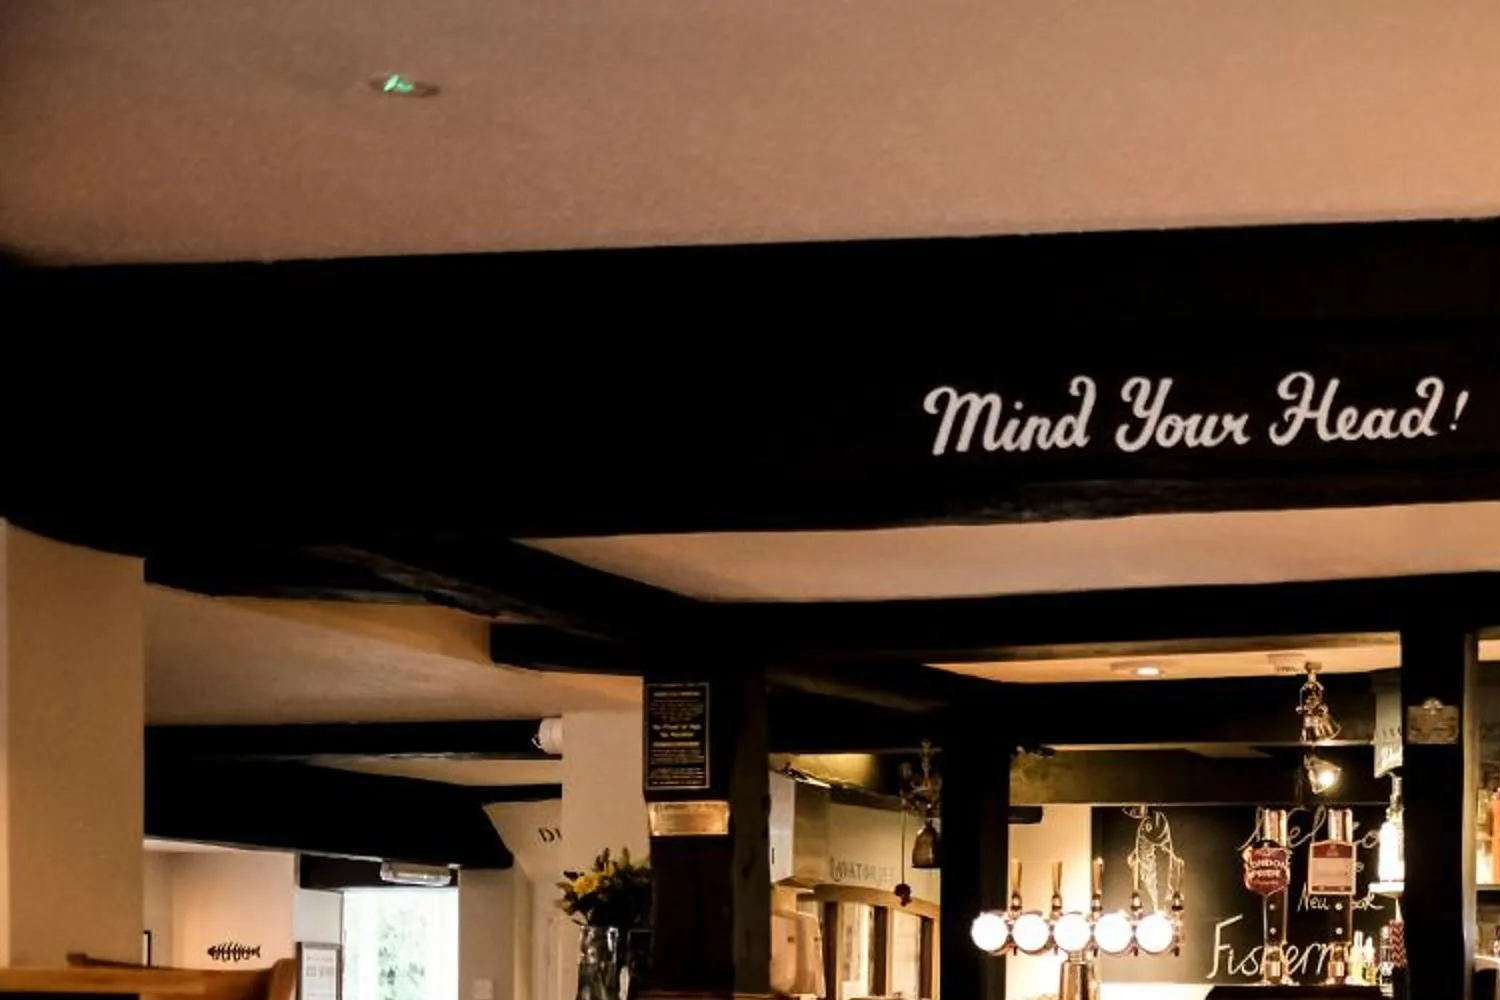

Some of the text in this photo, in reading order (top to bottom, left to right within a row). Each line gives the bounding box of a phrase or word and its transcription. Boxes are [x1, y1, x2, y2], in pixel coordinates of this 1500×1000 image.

[923, 371, 1469, 456] Mind Your Head!
